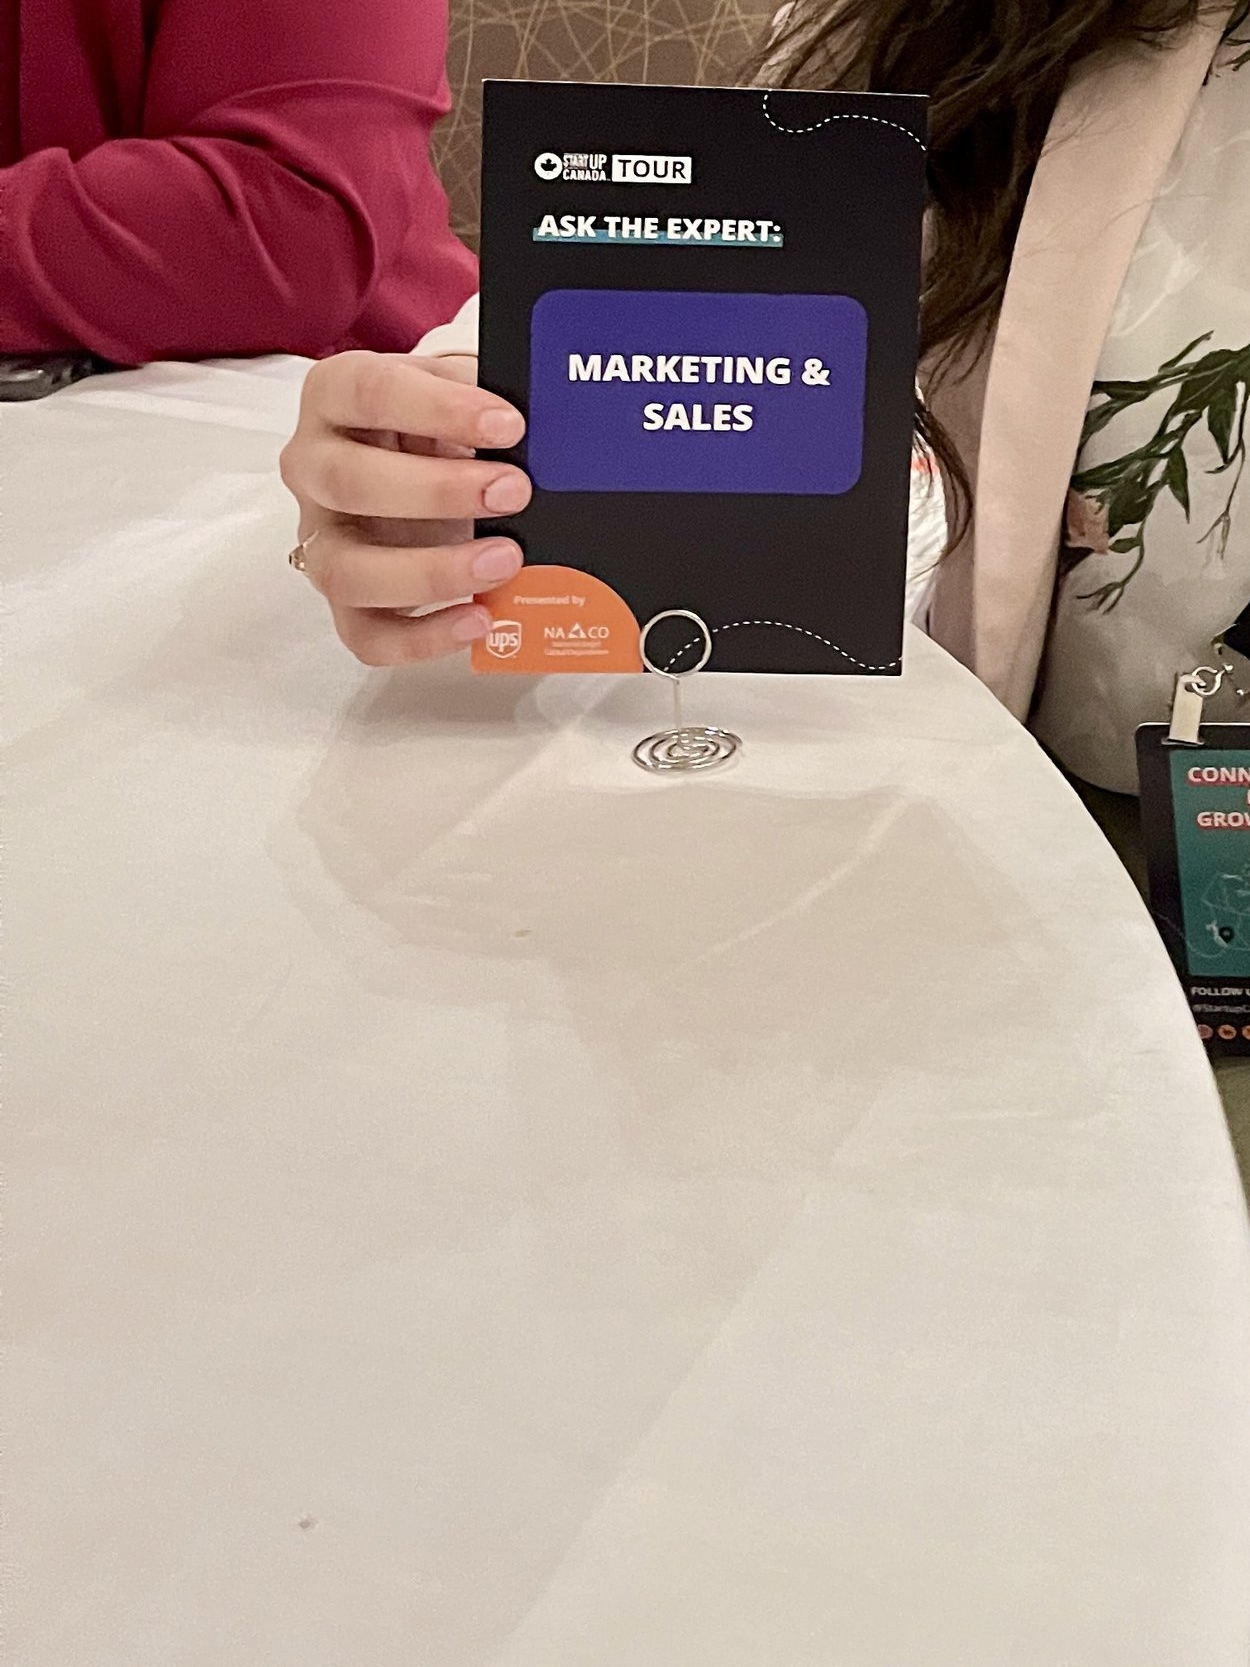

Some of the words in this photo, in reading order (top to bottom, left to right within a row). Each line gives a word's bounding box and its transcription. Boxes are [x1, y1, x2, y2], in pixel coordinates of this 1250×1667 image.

[618, 159, 686, 179] TOUR
[537, 215, 597, 238] ASK
[603, 216, 659, 238] THE
[667, 218, 782, 242] EXPERT:
[568, 354, 792, 385] MARKETING
[801, 358, 831, 386] &
[643, 403, 754, 431] SALES
[513, 595, 569, 605] Presented
[571, 595, 586, 607] by
[490, 633, 518, 652] ups
[1190, 986, 1242, 996] FOLLOW
